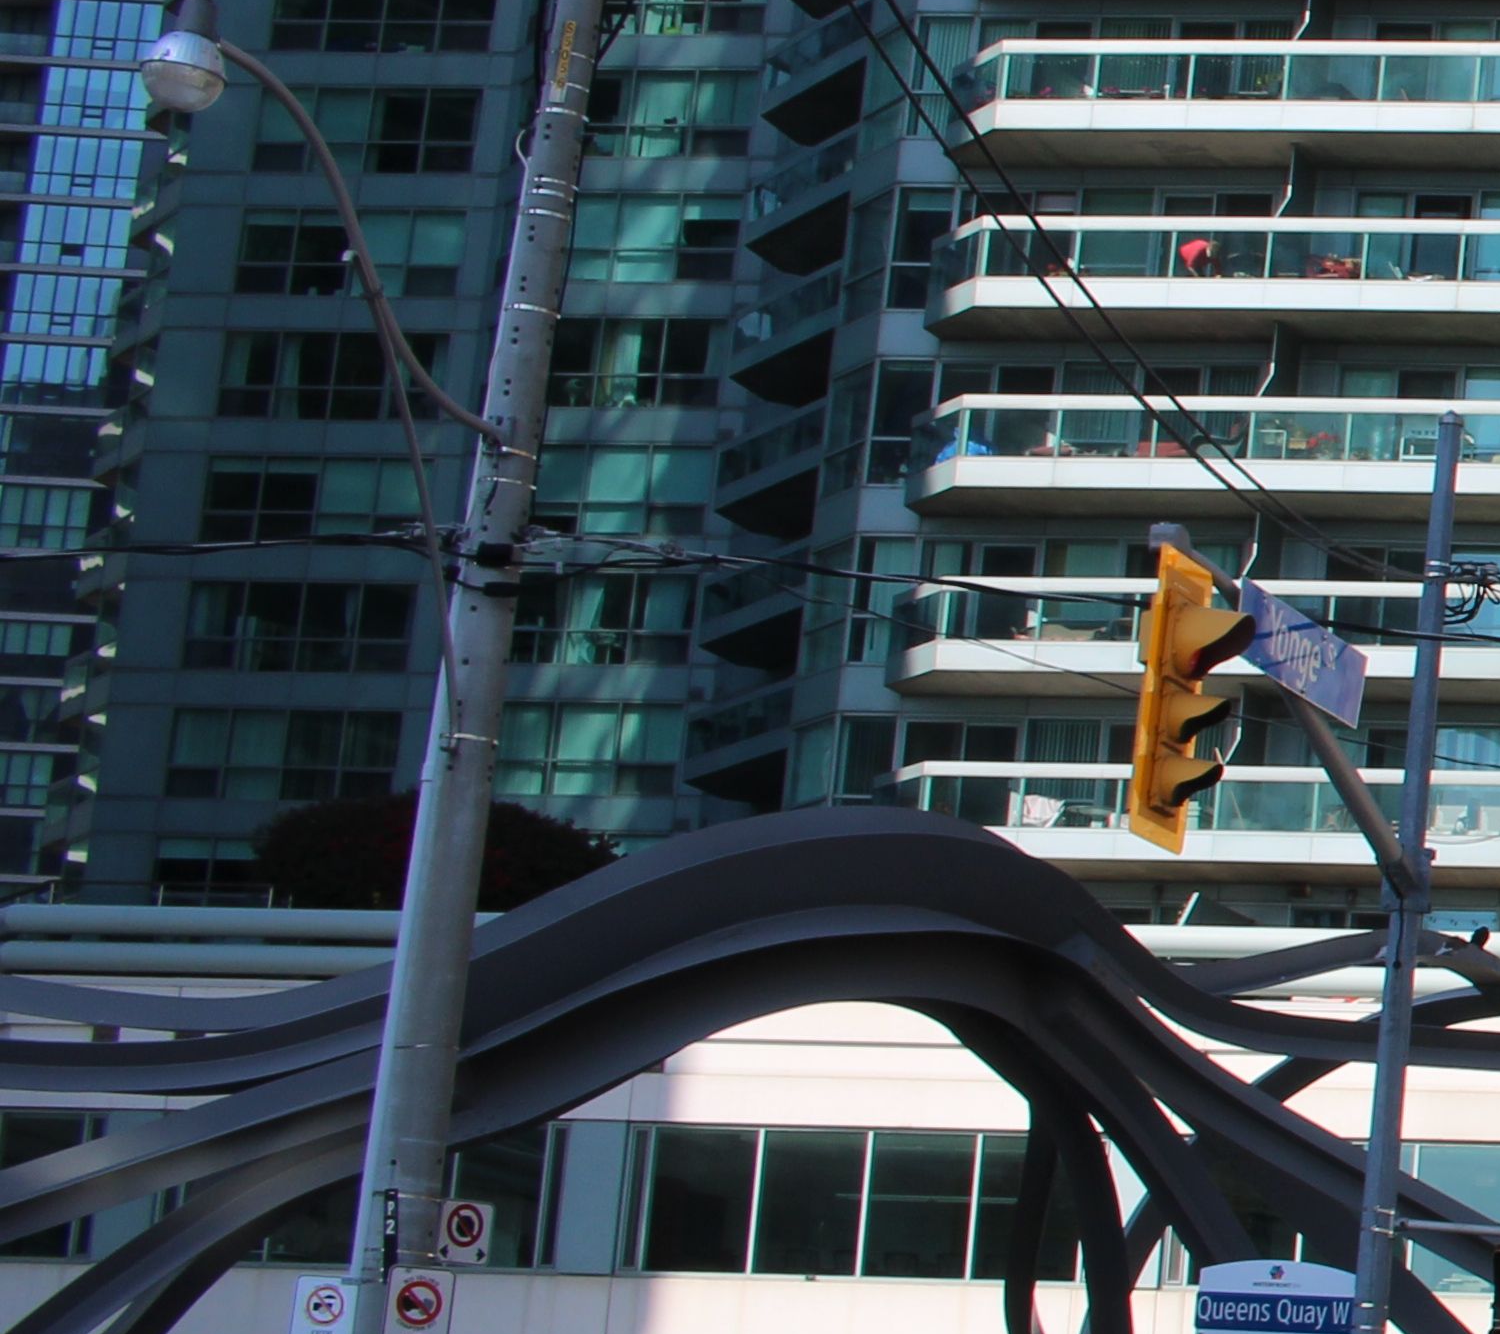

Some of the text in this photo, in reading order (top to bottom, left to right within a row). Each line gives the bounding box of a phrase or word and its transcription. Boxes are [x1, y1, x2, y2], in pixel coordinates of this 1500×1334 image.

[1270, 604, 1321, 691] Yonge
[387, 1201, 394, 1215] P
[386, 1220, 395, 1235] 2
[1198, 1295, 1350, 1330] Queens Quay W
